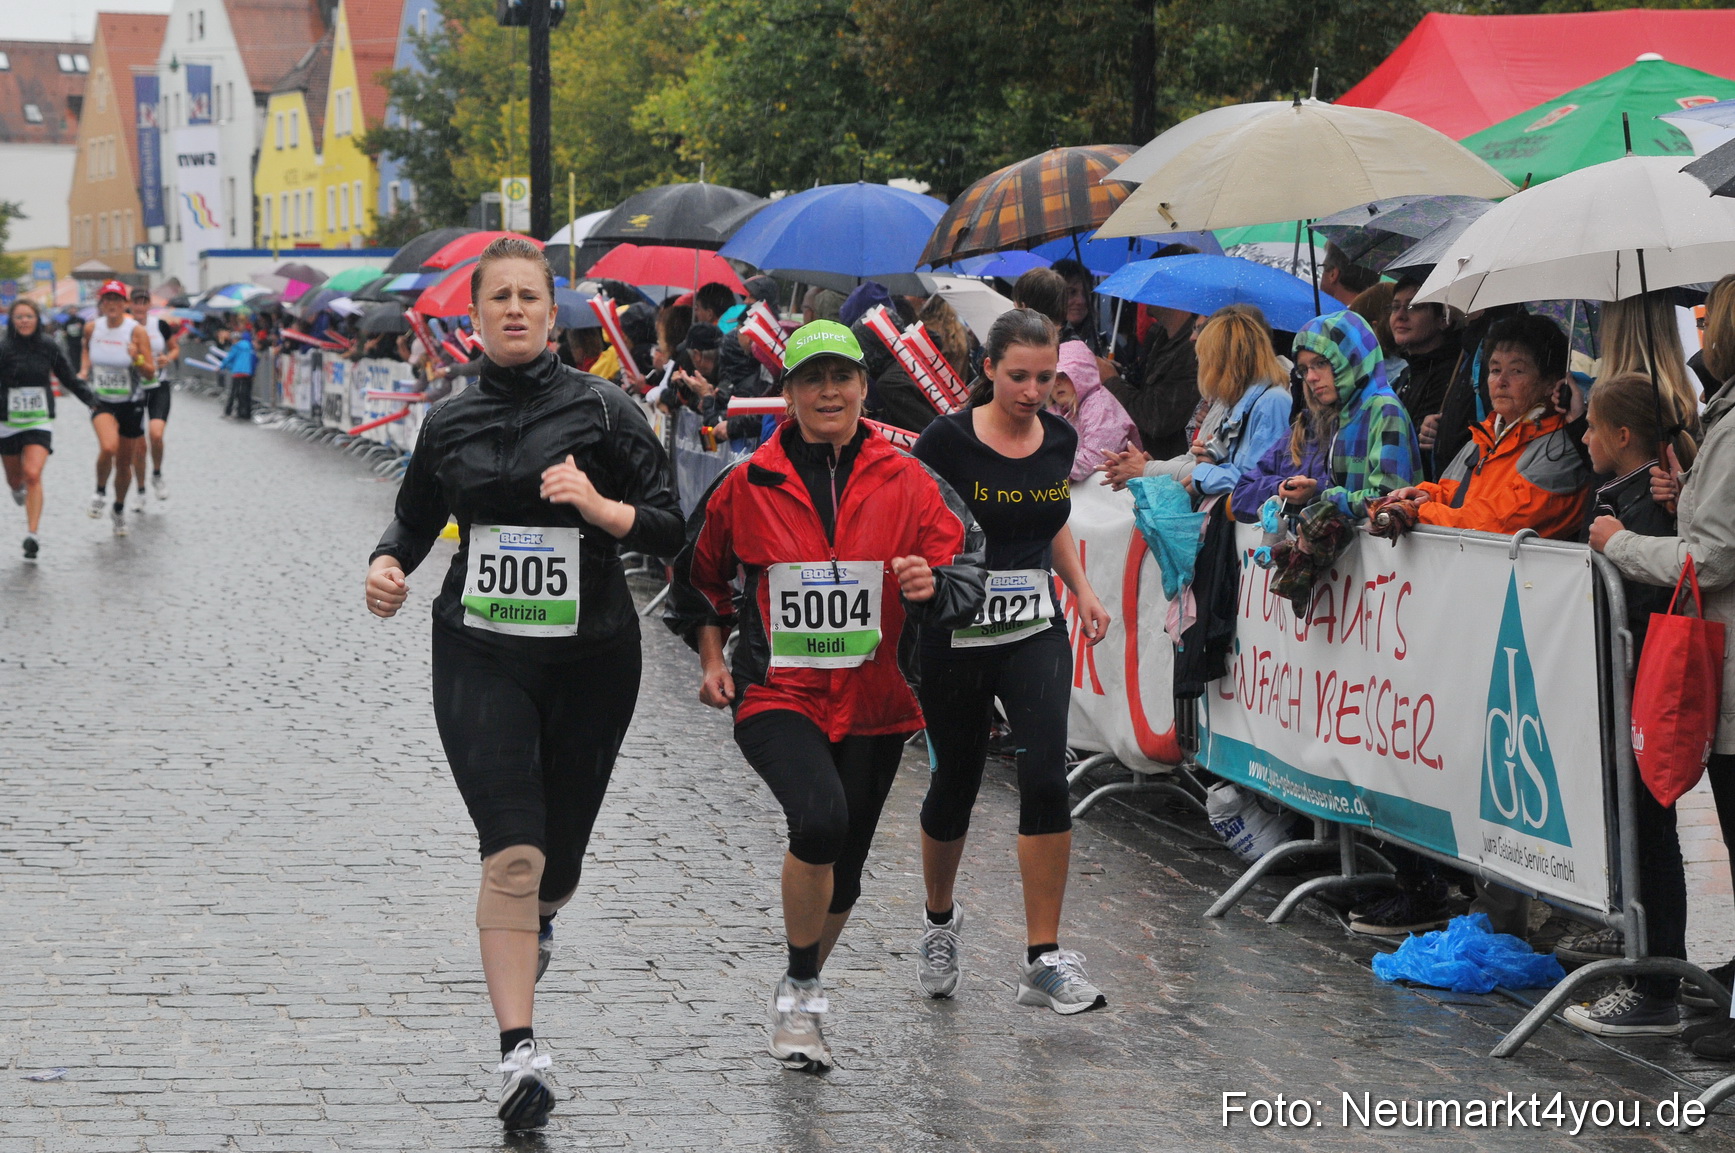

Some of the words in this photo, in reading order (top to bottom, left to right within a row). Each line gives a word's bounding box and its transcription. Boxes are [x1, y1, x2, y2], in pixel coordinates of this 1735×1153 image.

[795, 330, 848, 351] Sinupret
[883, 334, 952, 415] AUSTRIA
[974, 481, 989, 501] Is
[997, 490, 1023, 503] no
[500, 532, 544, 545] BOCK
[477, 553, 568, 597] 5005
[801, 567, 848, 580] BOCK
[990, 575, 1028, 587] BOCK
[489, 602, 547, 622] Patrizia
[781, 589, 871, 630] 5004
[806, 636, 846, 654] Heidi
[1314, 669, 1444, 771] BESSER.
[1482, 831, 1498, 855] Jura
[1497, 836, 1524, 866] Gebäude
[1523, 846, 1549, 876] Service
[1550, 855, 1576, 883] GmbH
